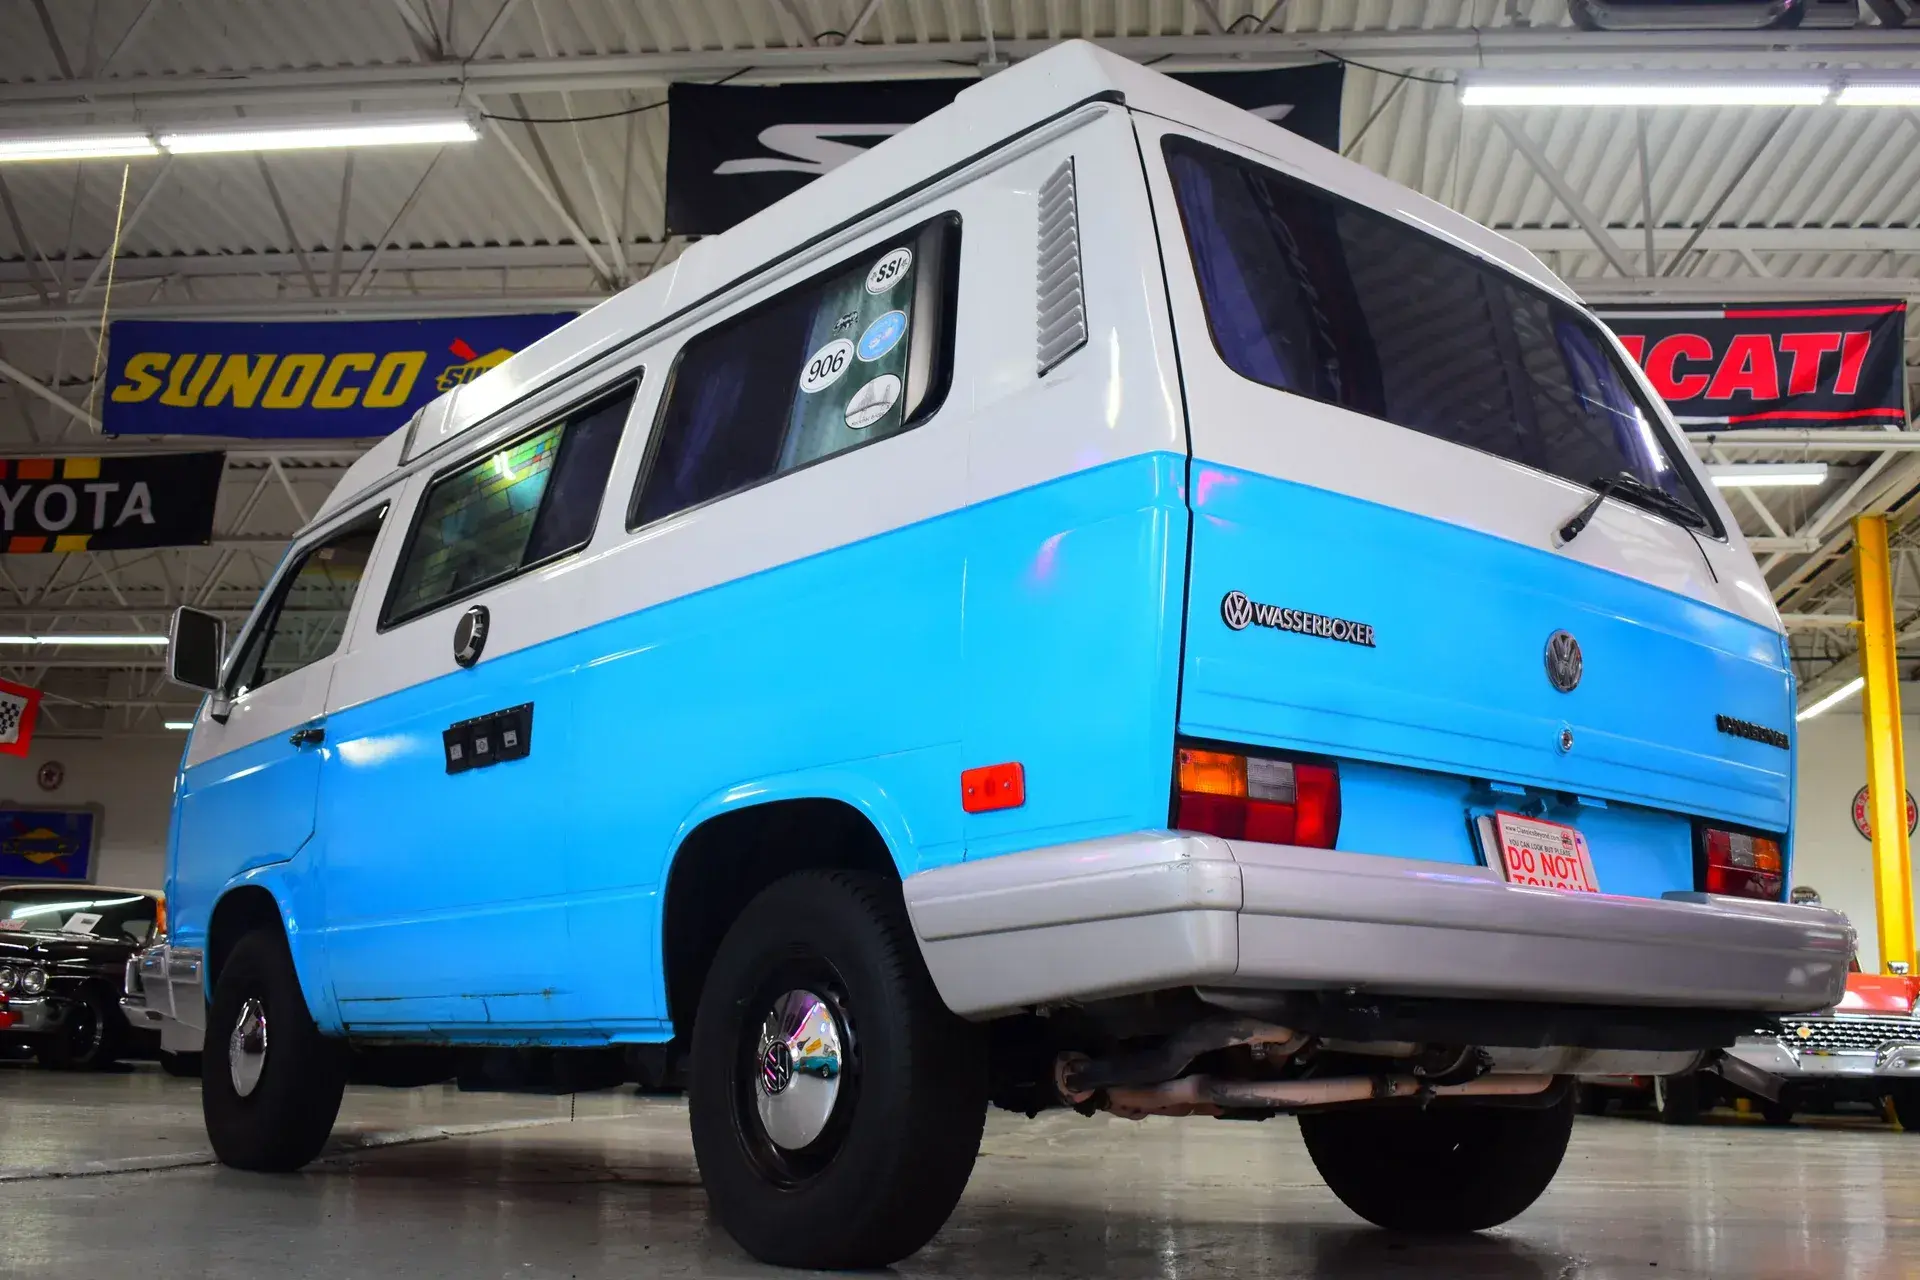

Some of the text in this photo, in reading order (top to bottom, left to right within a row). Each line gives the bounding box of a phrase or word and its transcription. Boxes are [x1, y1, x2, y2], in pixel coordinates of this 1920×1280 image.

[111, 351, 428, 409] SUNOCO
[808, 349, 846, 383] 906
[1614, 331, 1871, 401] CATI
[1253, 603, 1376, 648] WASSERBOXER
[1508, 846, 1577, 881] DO NOT
[1520, 841, 1530, 849] CAN
[1531, 843, 1543, 852] LOOK
